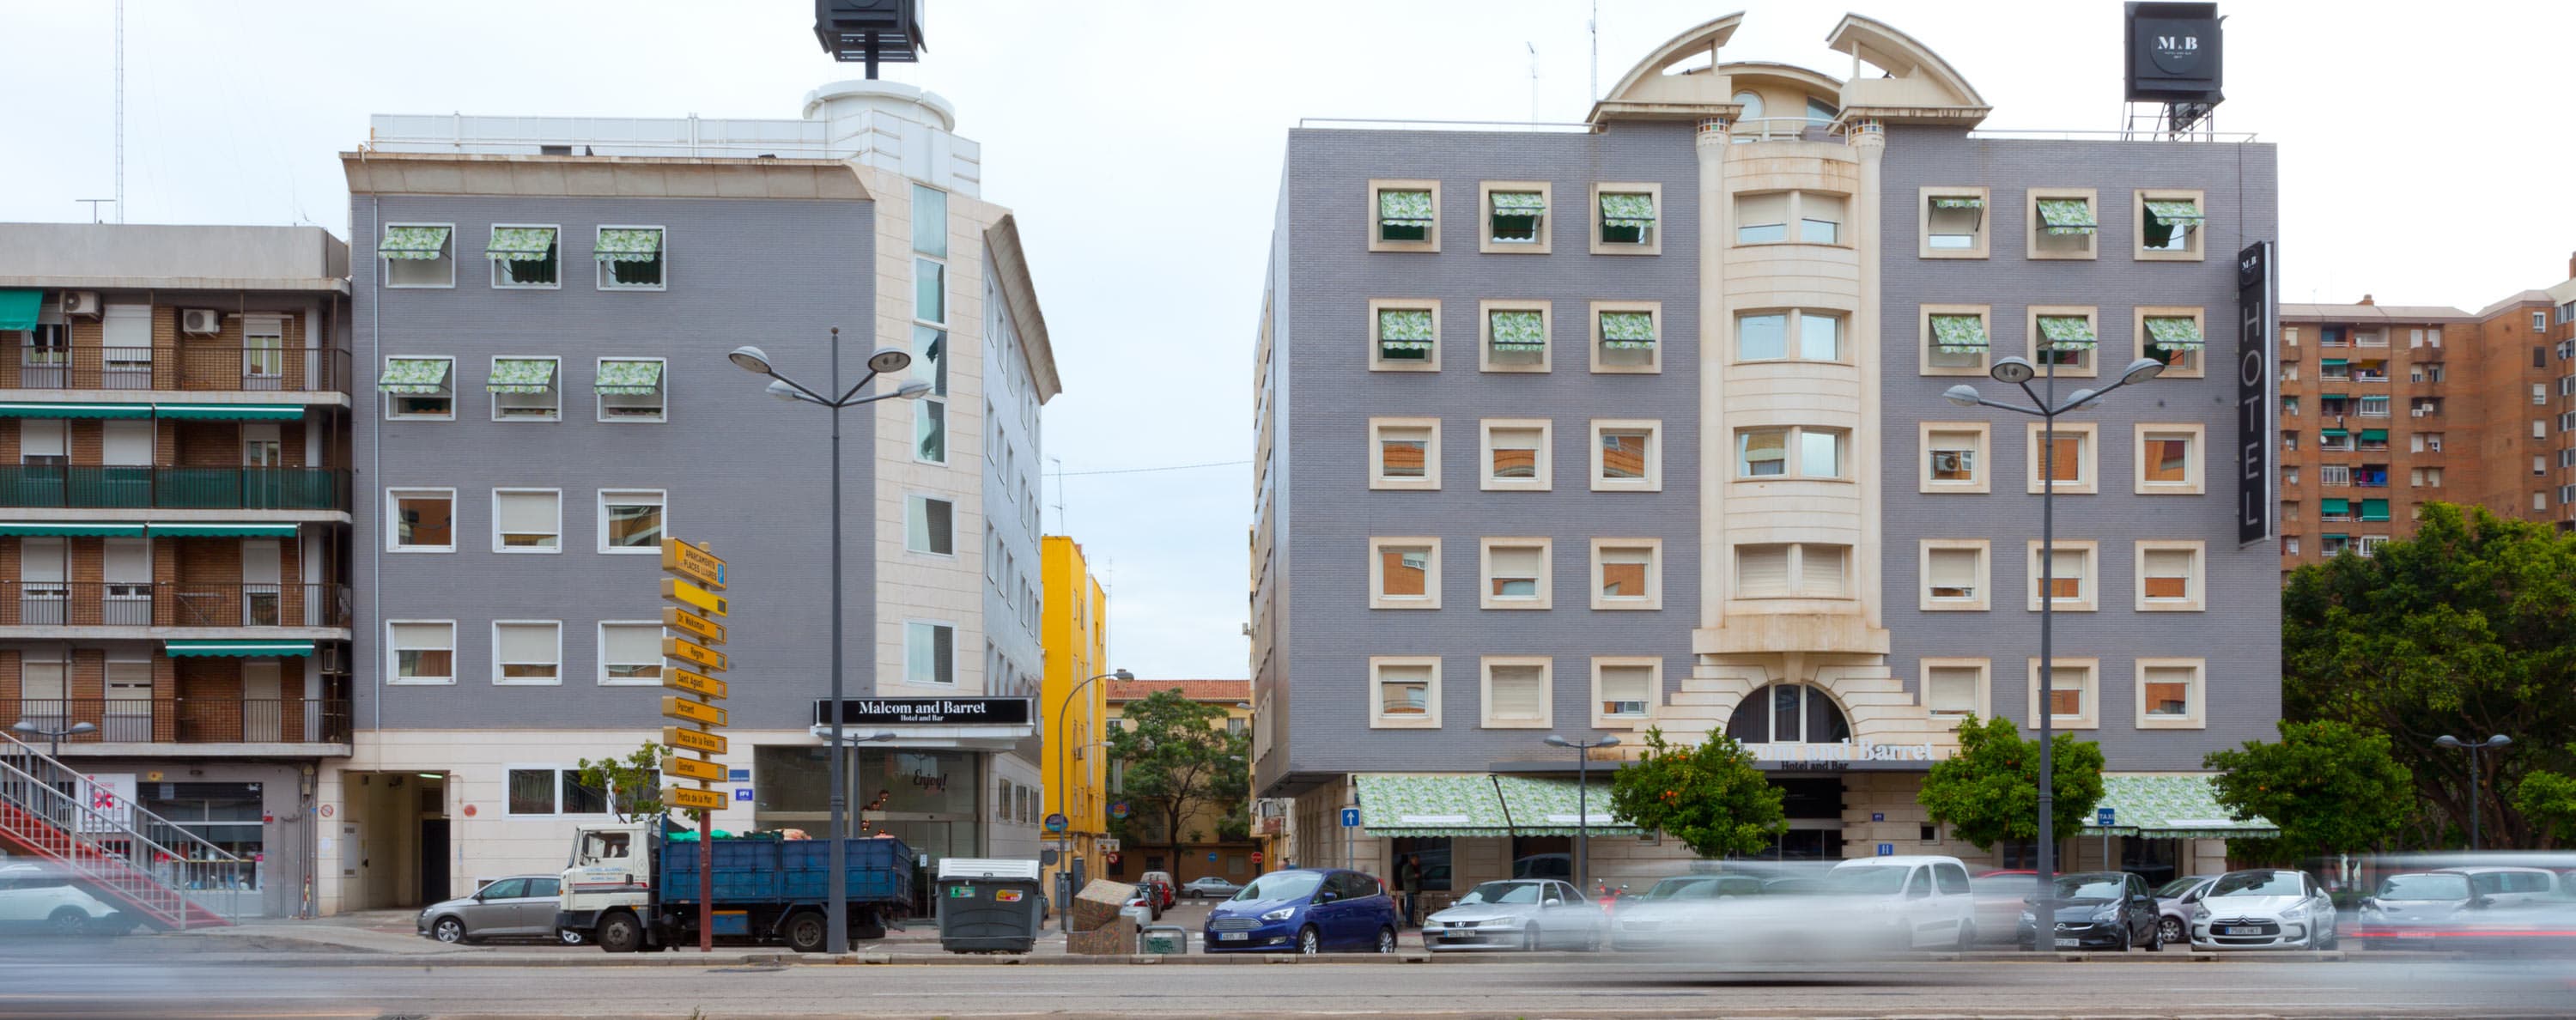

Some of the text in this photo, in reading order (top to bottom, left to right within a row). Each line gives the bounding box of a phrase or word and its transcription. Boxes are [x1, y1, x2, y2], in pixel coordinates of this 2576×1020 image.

[2242, 301, 2262, 525] HOTEL
[677, 672, 689, 683] Sant
[859, 701, 987, 713] Malcom and Barret
[1807, 738, 1850, 761] and
[1858, 738, 1935, 761] Barret
[1782, 761, 1849, 770] Hotel and Bar
[914, 769, 948, 792] Enjoy!
[1882, 844, 1889, 855] H
